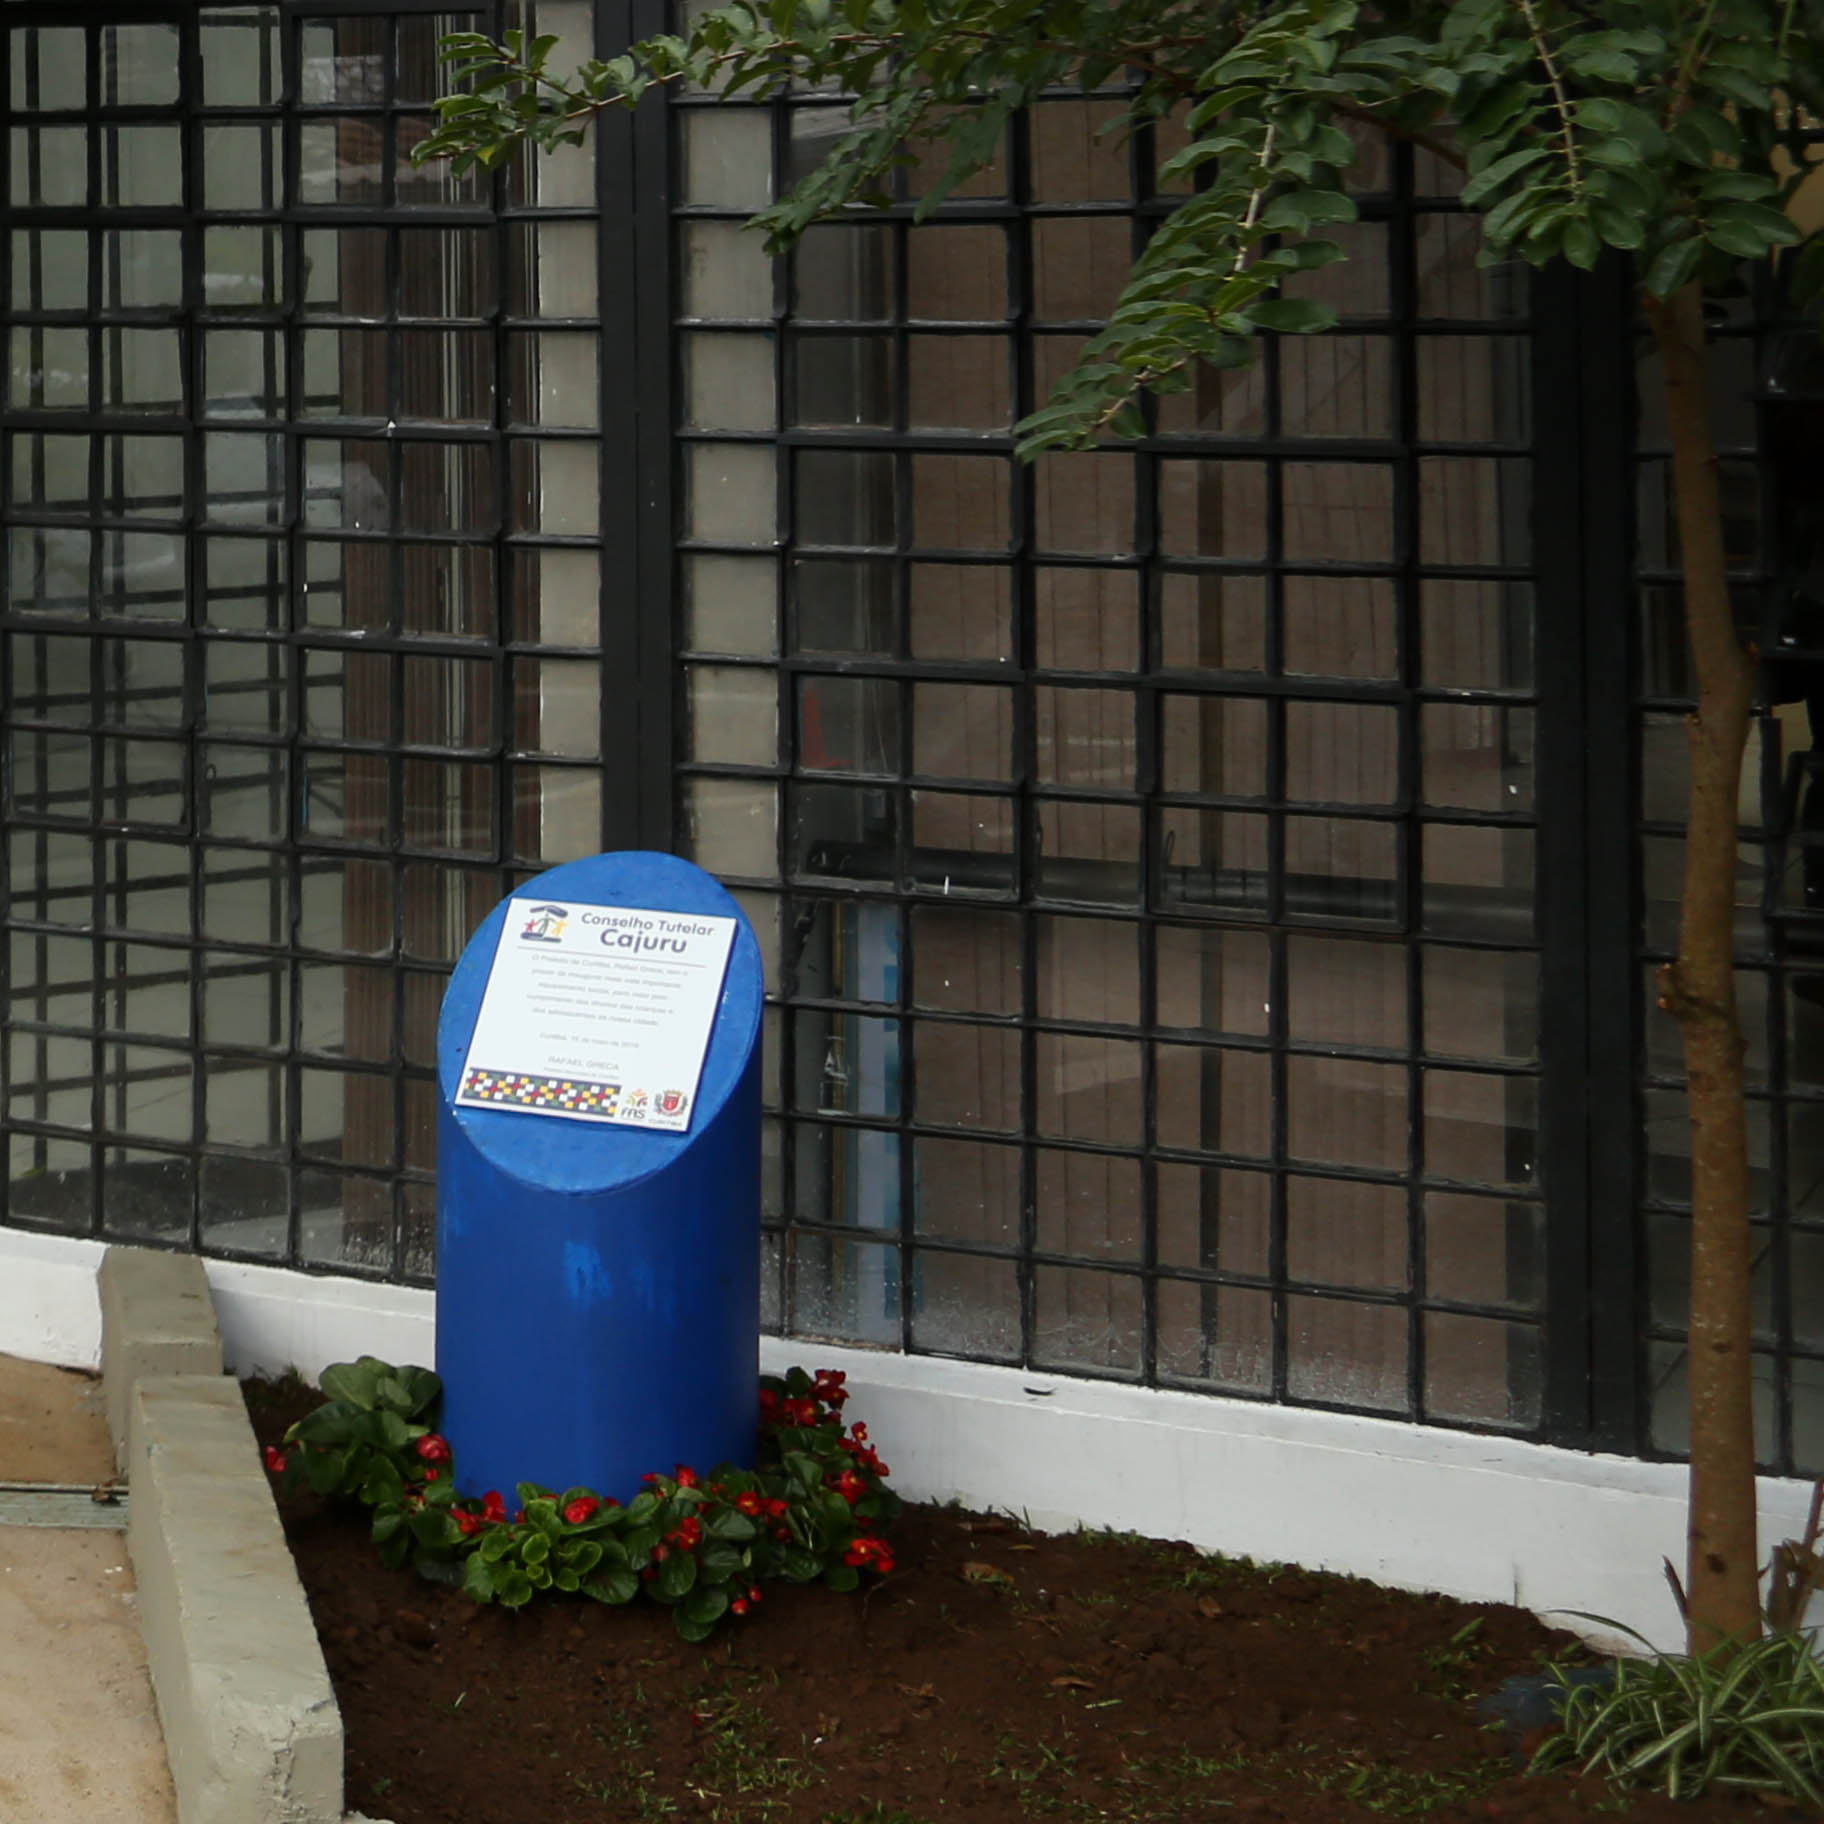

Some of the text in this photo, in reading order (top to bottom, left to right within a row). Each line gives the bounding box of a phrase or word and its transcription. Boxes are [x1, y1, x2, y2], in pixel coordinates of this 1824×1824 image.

[581, 912, 715, 936] Conselho Tutelar
[600, 928, 687, 953] Cajuru
